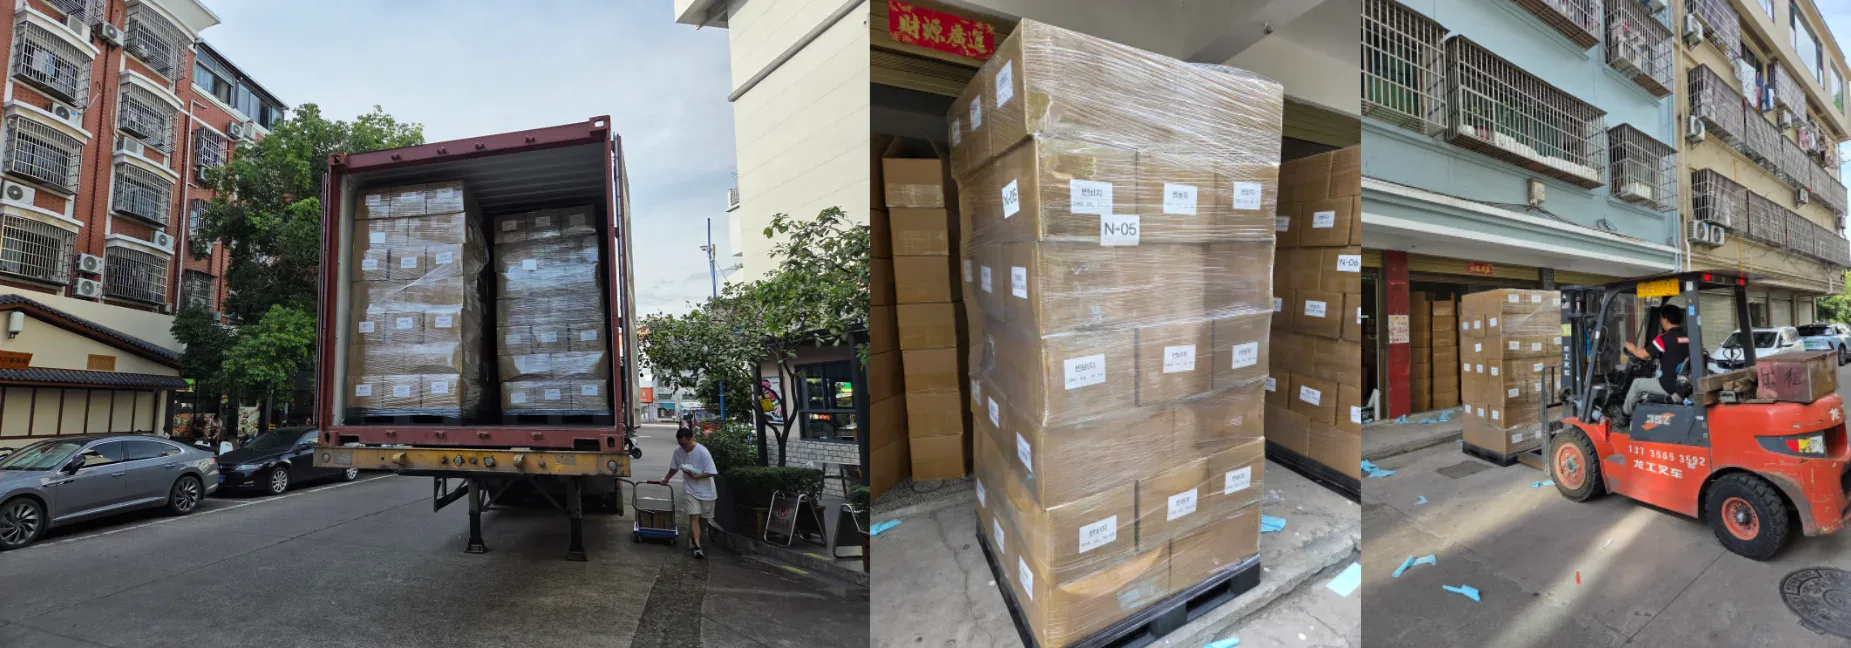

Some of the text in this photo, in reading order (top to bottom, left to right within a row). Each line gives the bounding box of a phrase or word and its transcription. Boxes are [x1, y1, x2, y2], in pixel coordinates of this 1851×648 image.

[1104, 222, 1137, 236] N-05
[1339, 259, 1359, 267] N-06
[1628, 445, 1645, 455] 137
[1633, 459, 1683, 479] 龙工叉车
